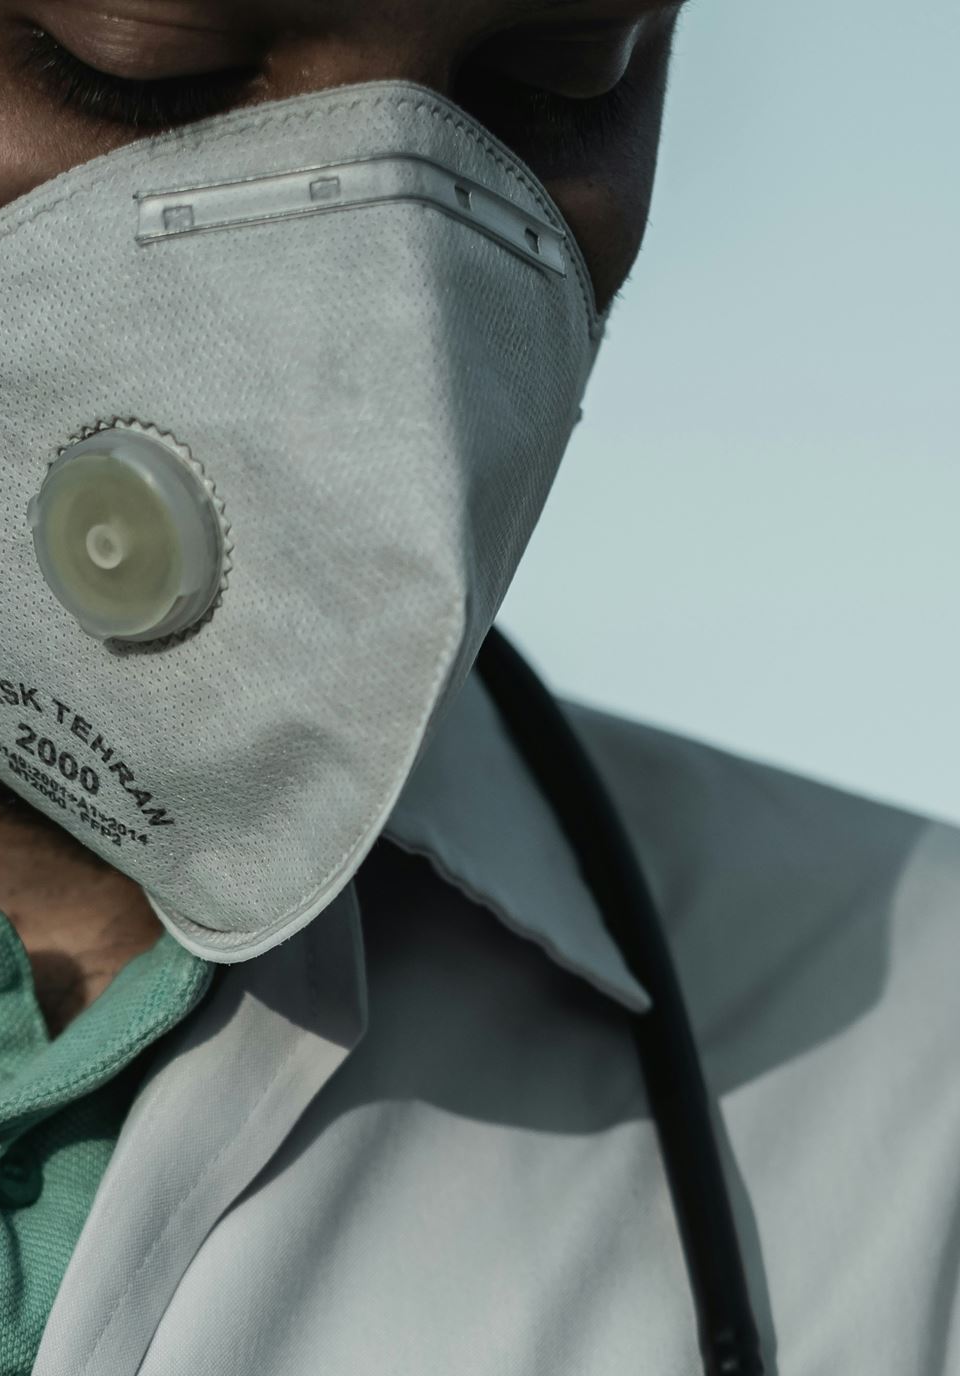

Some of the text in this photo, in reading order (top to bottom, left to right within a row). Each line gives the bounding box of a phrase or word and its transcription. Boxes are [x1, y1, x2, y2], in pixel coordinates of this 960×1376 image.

[15, 722, 100, 796] 2000
[52, 698, 175, 827] TEHRAN
[79, 811, 122, 847] FFP2
